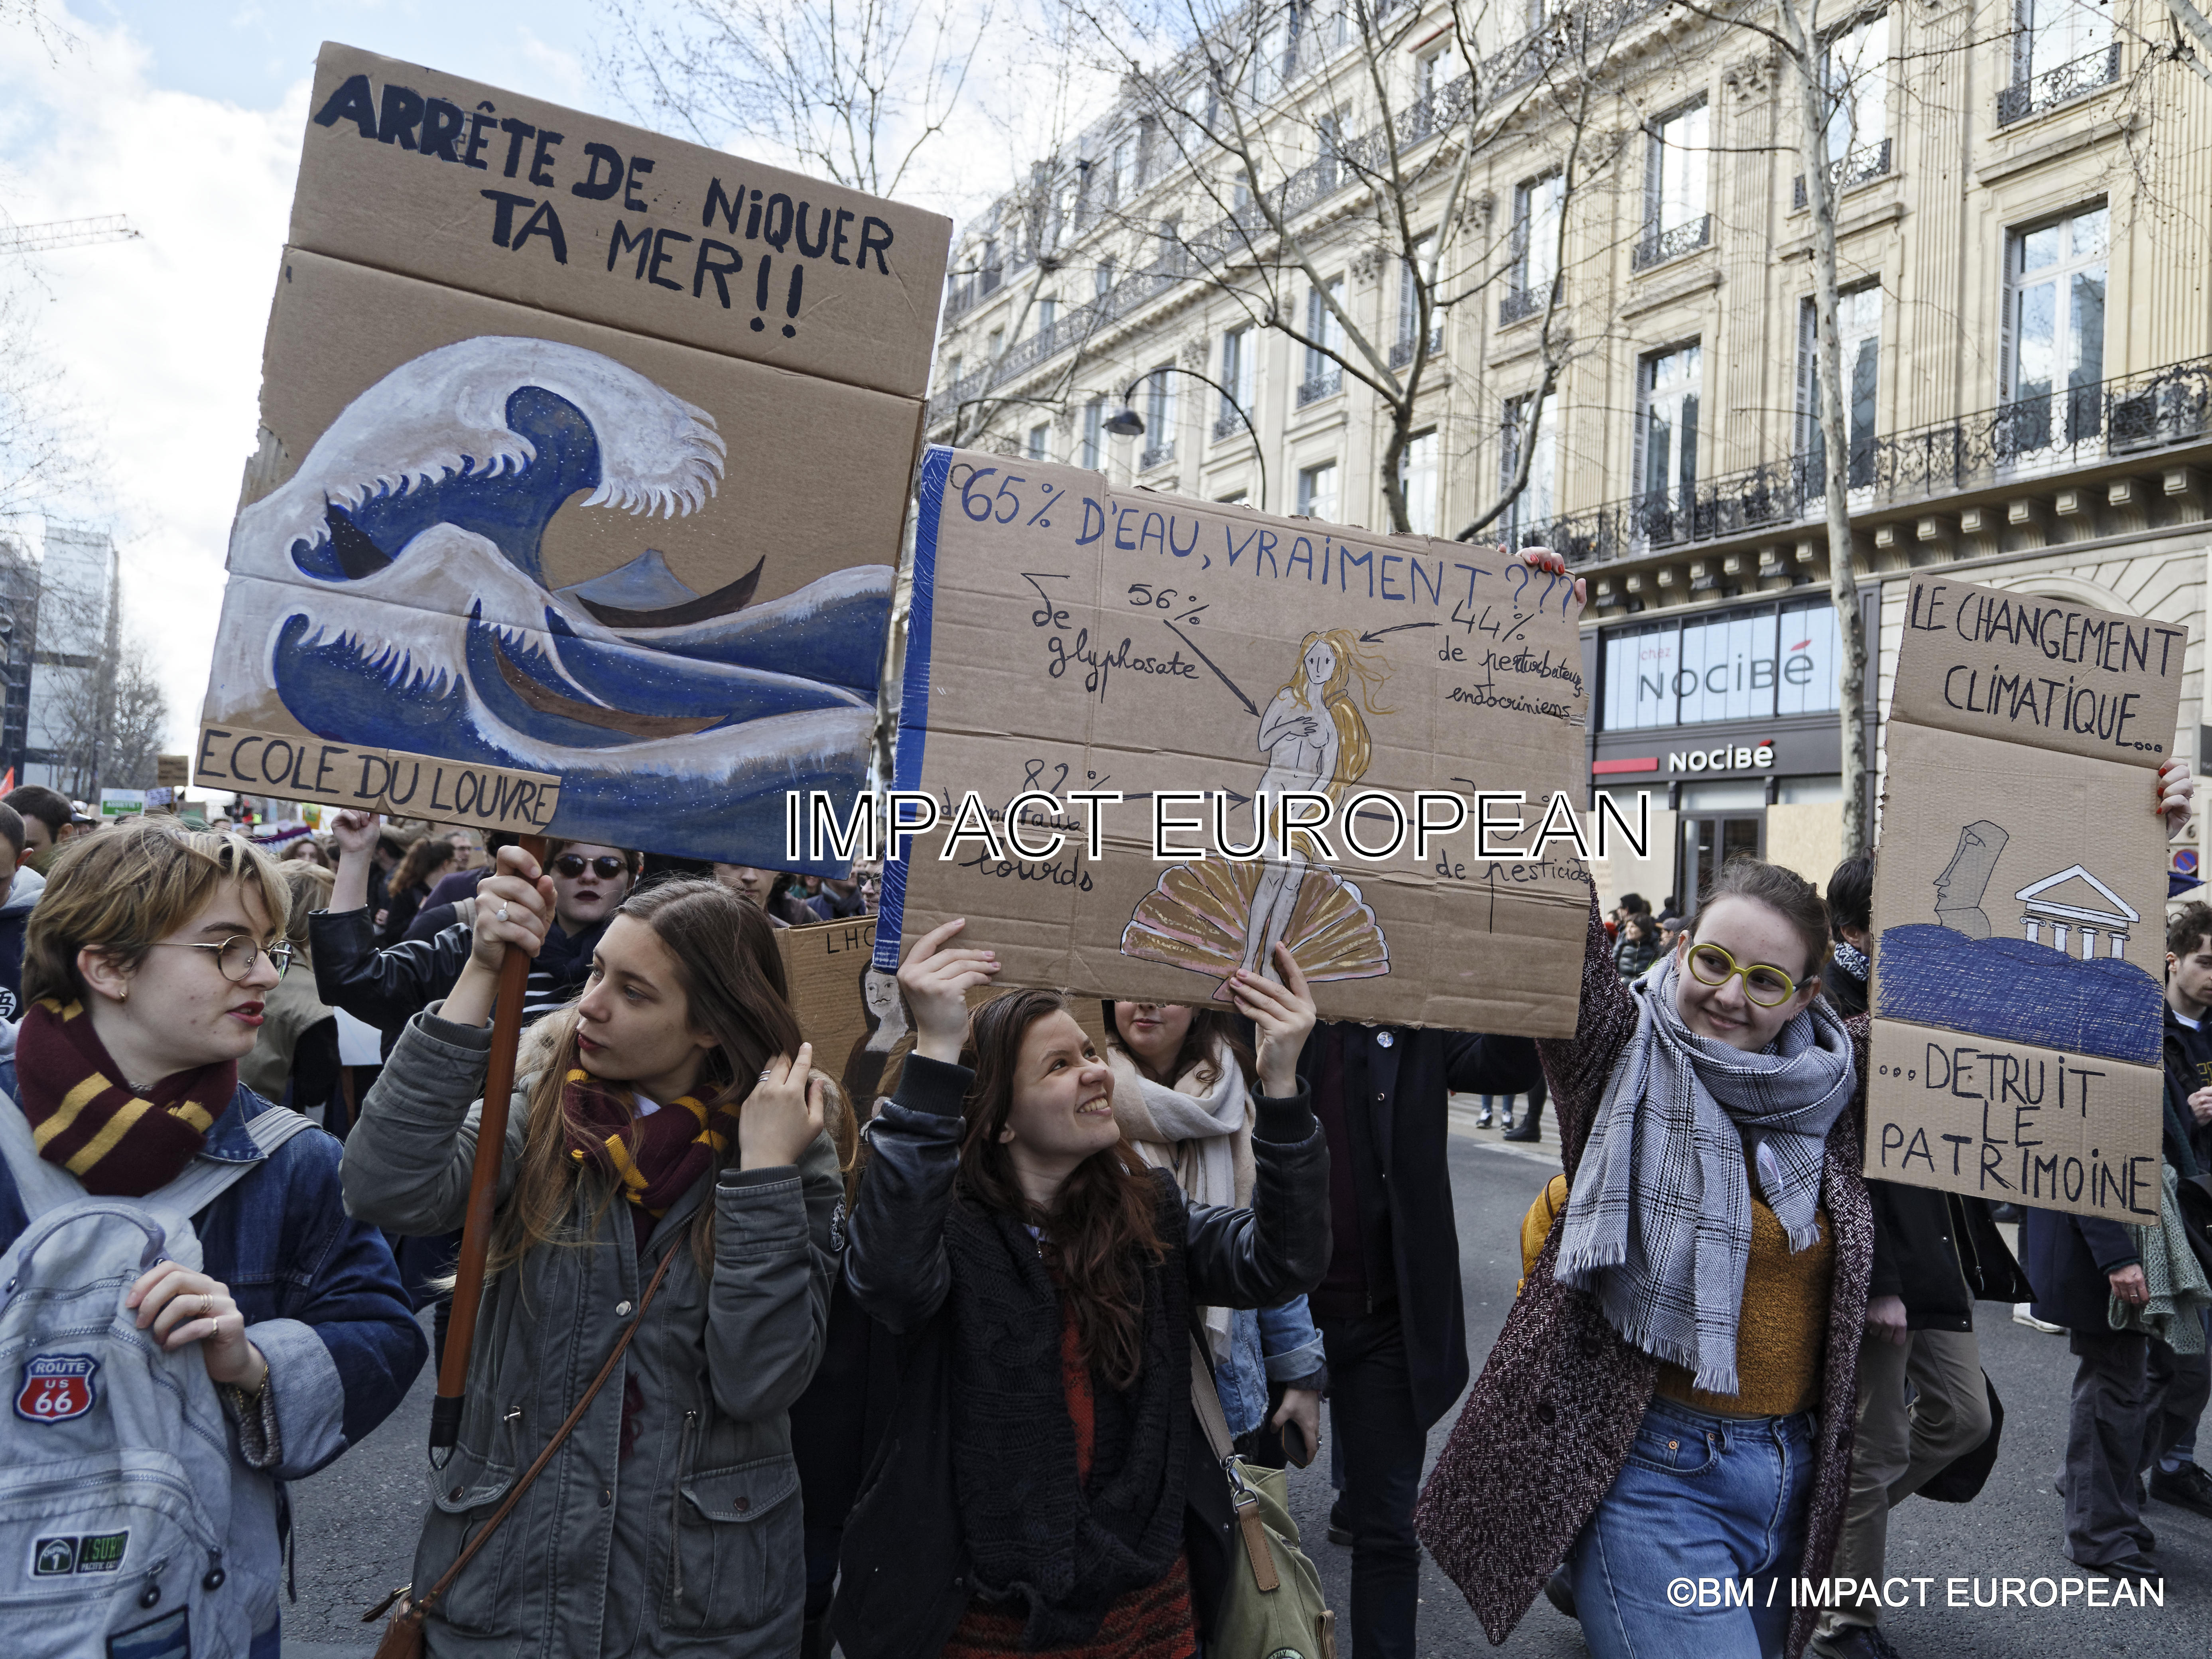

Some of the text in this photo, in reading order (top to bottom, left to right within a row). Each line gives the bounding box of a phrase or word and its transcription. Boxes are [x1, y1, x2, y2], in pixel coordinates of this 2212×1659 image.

[313, 75, 565, 187] ARRÊTE
[572, 142, 656, 213] DE
[480, 189, 804, 338] TA MER!!
[1021, 573, 1073, 629] de
[1439, 635, 1467, 662] de
[1641, 646, 1671, 661] chez
[1911, 583, 2183, 677] LE CHANGEMENT
[1048, 627, 1200, 704] glyphosate
[198, 728, 560, 826] ECOLE DU LOUVRE
[958, 837, 1093, 892] lourds
[1436, 849, 1466, 881] de
[1983, 1099, 2043, 1148] LE
[35, 1362, 86, 1373] ROUTE
[35, 1391, 72, 1413] 66
